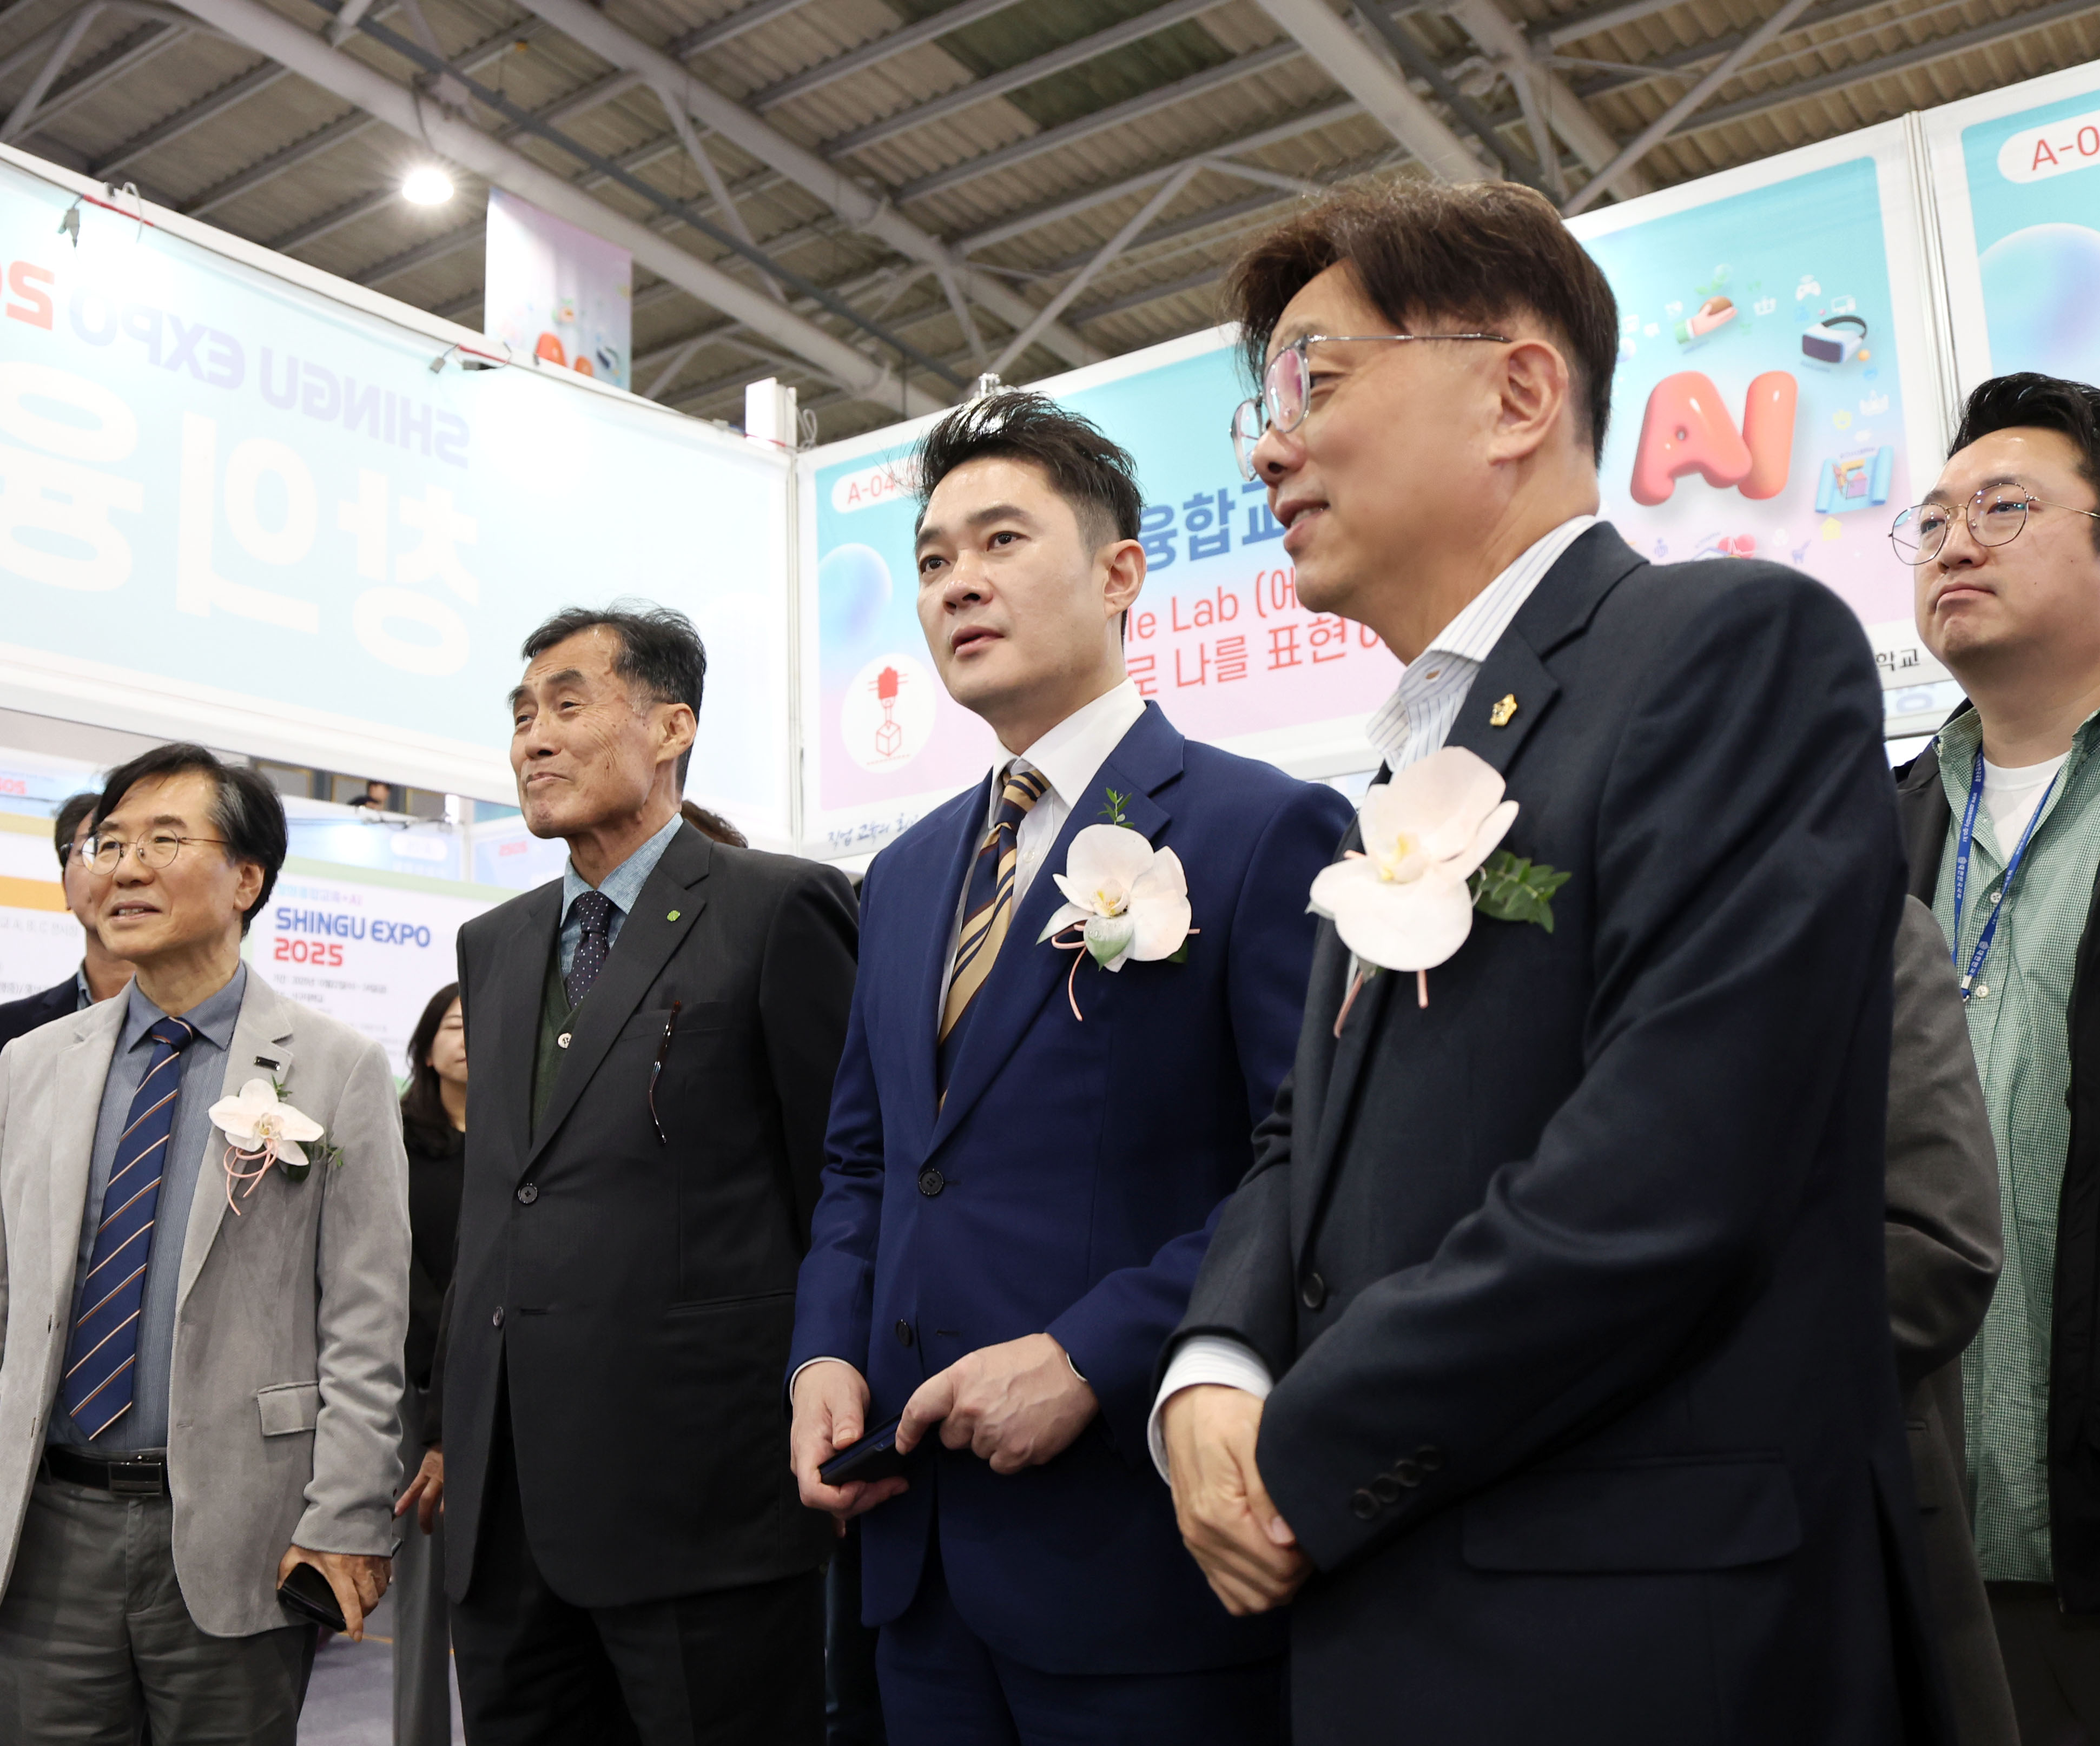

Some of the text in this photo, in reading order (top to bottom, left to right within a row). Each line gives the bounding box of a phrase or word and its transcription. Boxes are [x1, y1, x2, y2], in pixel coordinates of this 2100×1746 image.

[1630, 370, 1799, 506] AI
[1172, 586, 1239, 632] Lab
[1176, 634, 1249, 687] 나를
[1268, 616, 1346, 671] 표현
[276, 907, 431, 948] SHINGU EXPO
[274, 937, 344, 967] 2025
